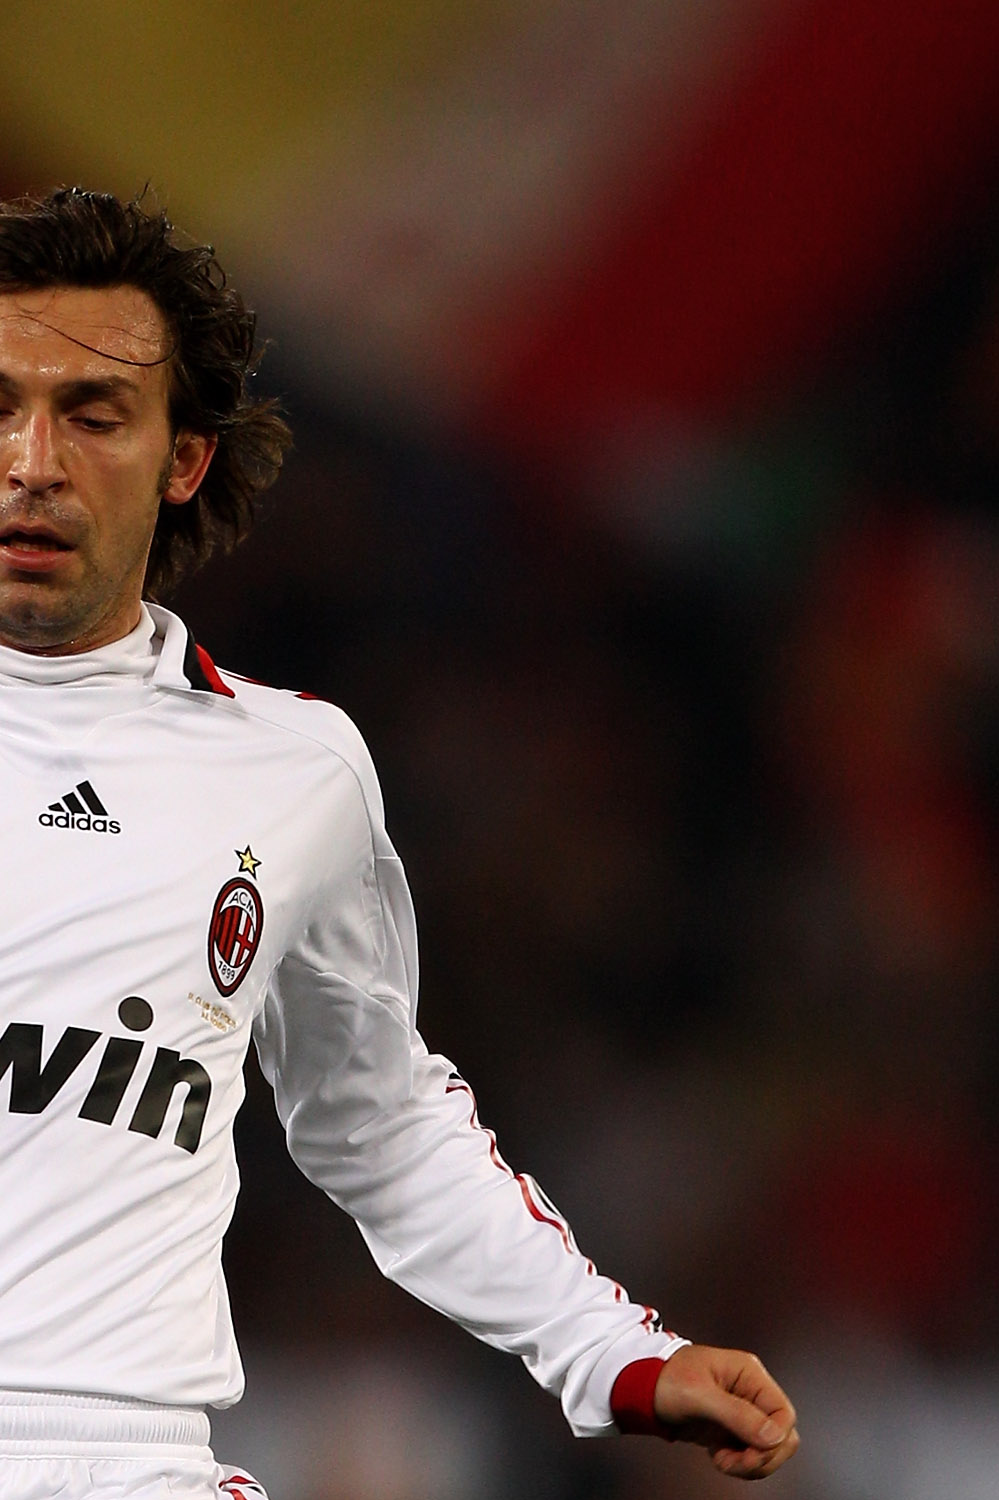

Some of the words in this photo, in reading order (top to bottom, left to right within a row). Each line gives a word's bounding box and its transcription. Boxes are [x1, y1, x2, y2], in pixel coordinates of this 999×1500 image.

[38, 812, 121, 834] adidas
[228, 891, 255, 917] ACM
[217, 960, 236, 981] 1899
